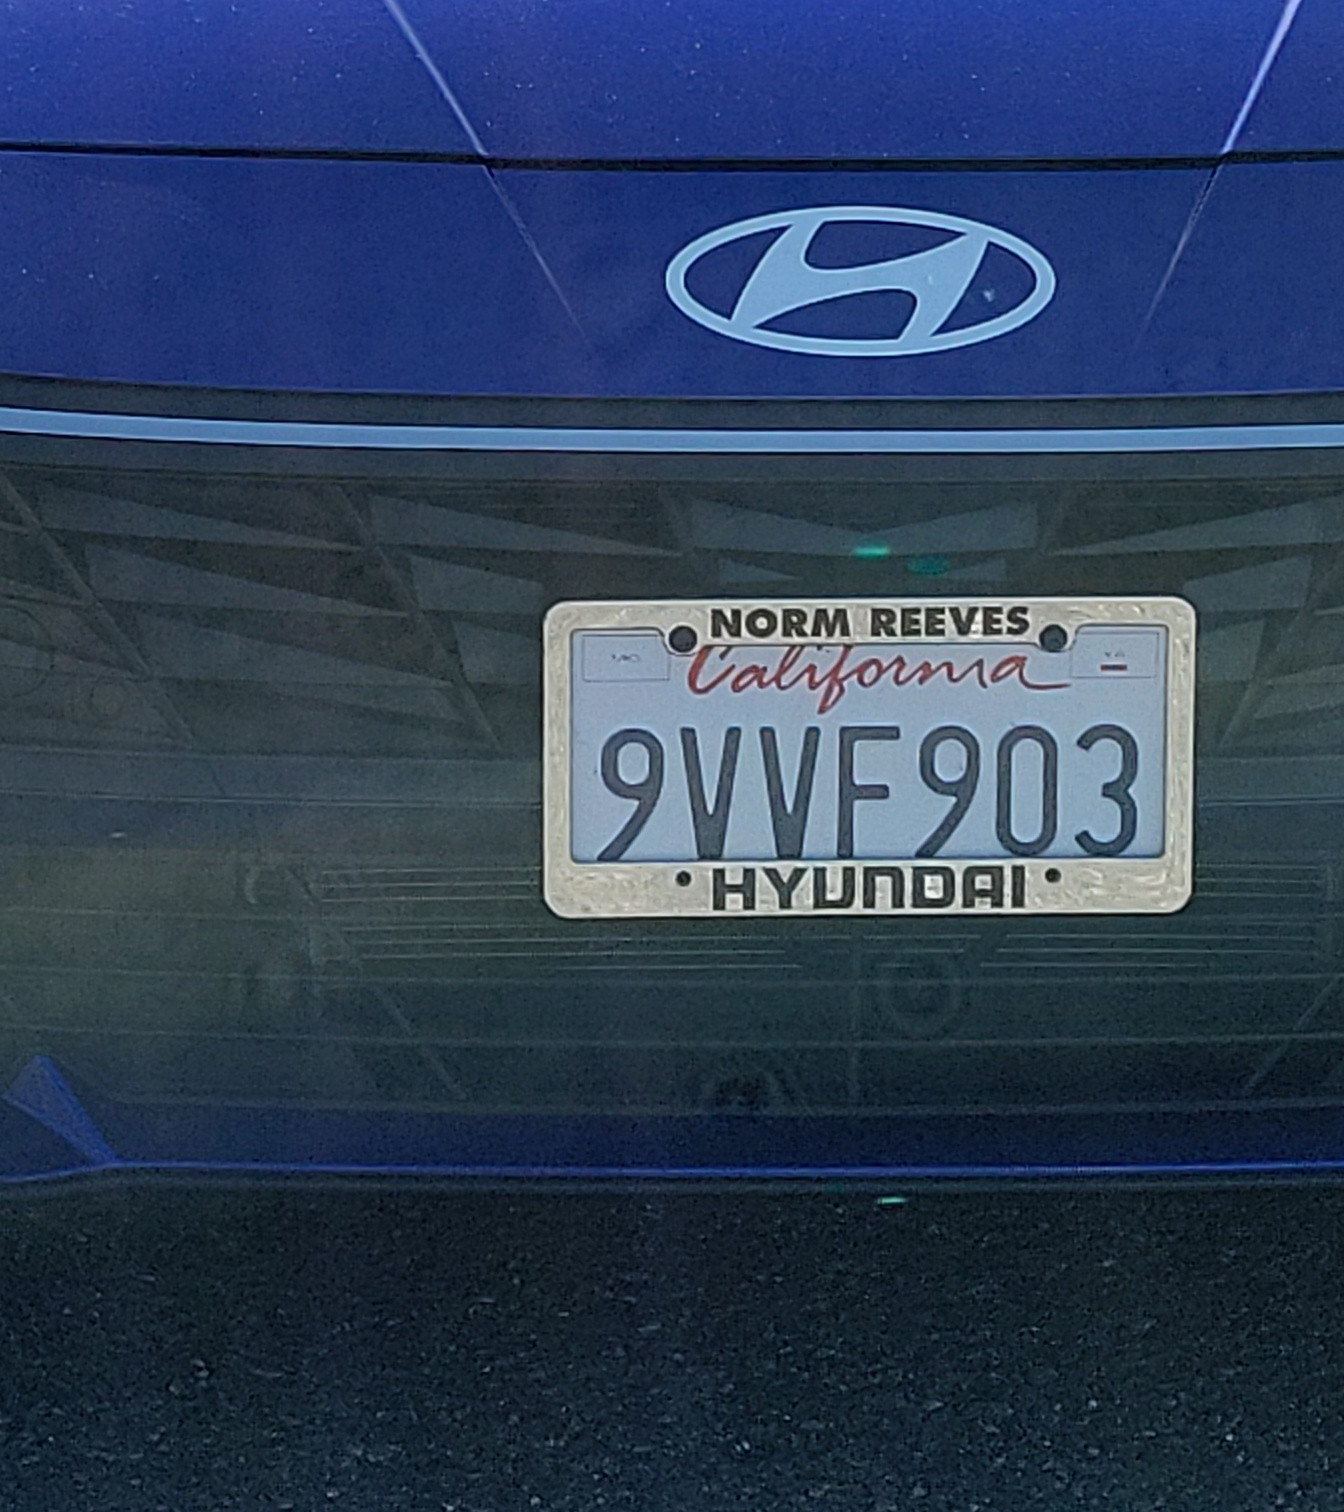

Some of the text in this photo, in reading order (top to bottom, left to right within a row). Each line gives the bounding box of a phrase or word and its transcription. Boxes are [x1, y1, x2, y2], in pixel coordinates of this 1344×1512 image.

[710, 606, 1032, 638] NORM REEVES
[686, 644, 1072, 714] California
[597, 723, 1141, 861] 9VVF903
[711, 864, 1027, 912] HYUNDAI
